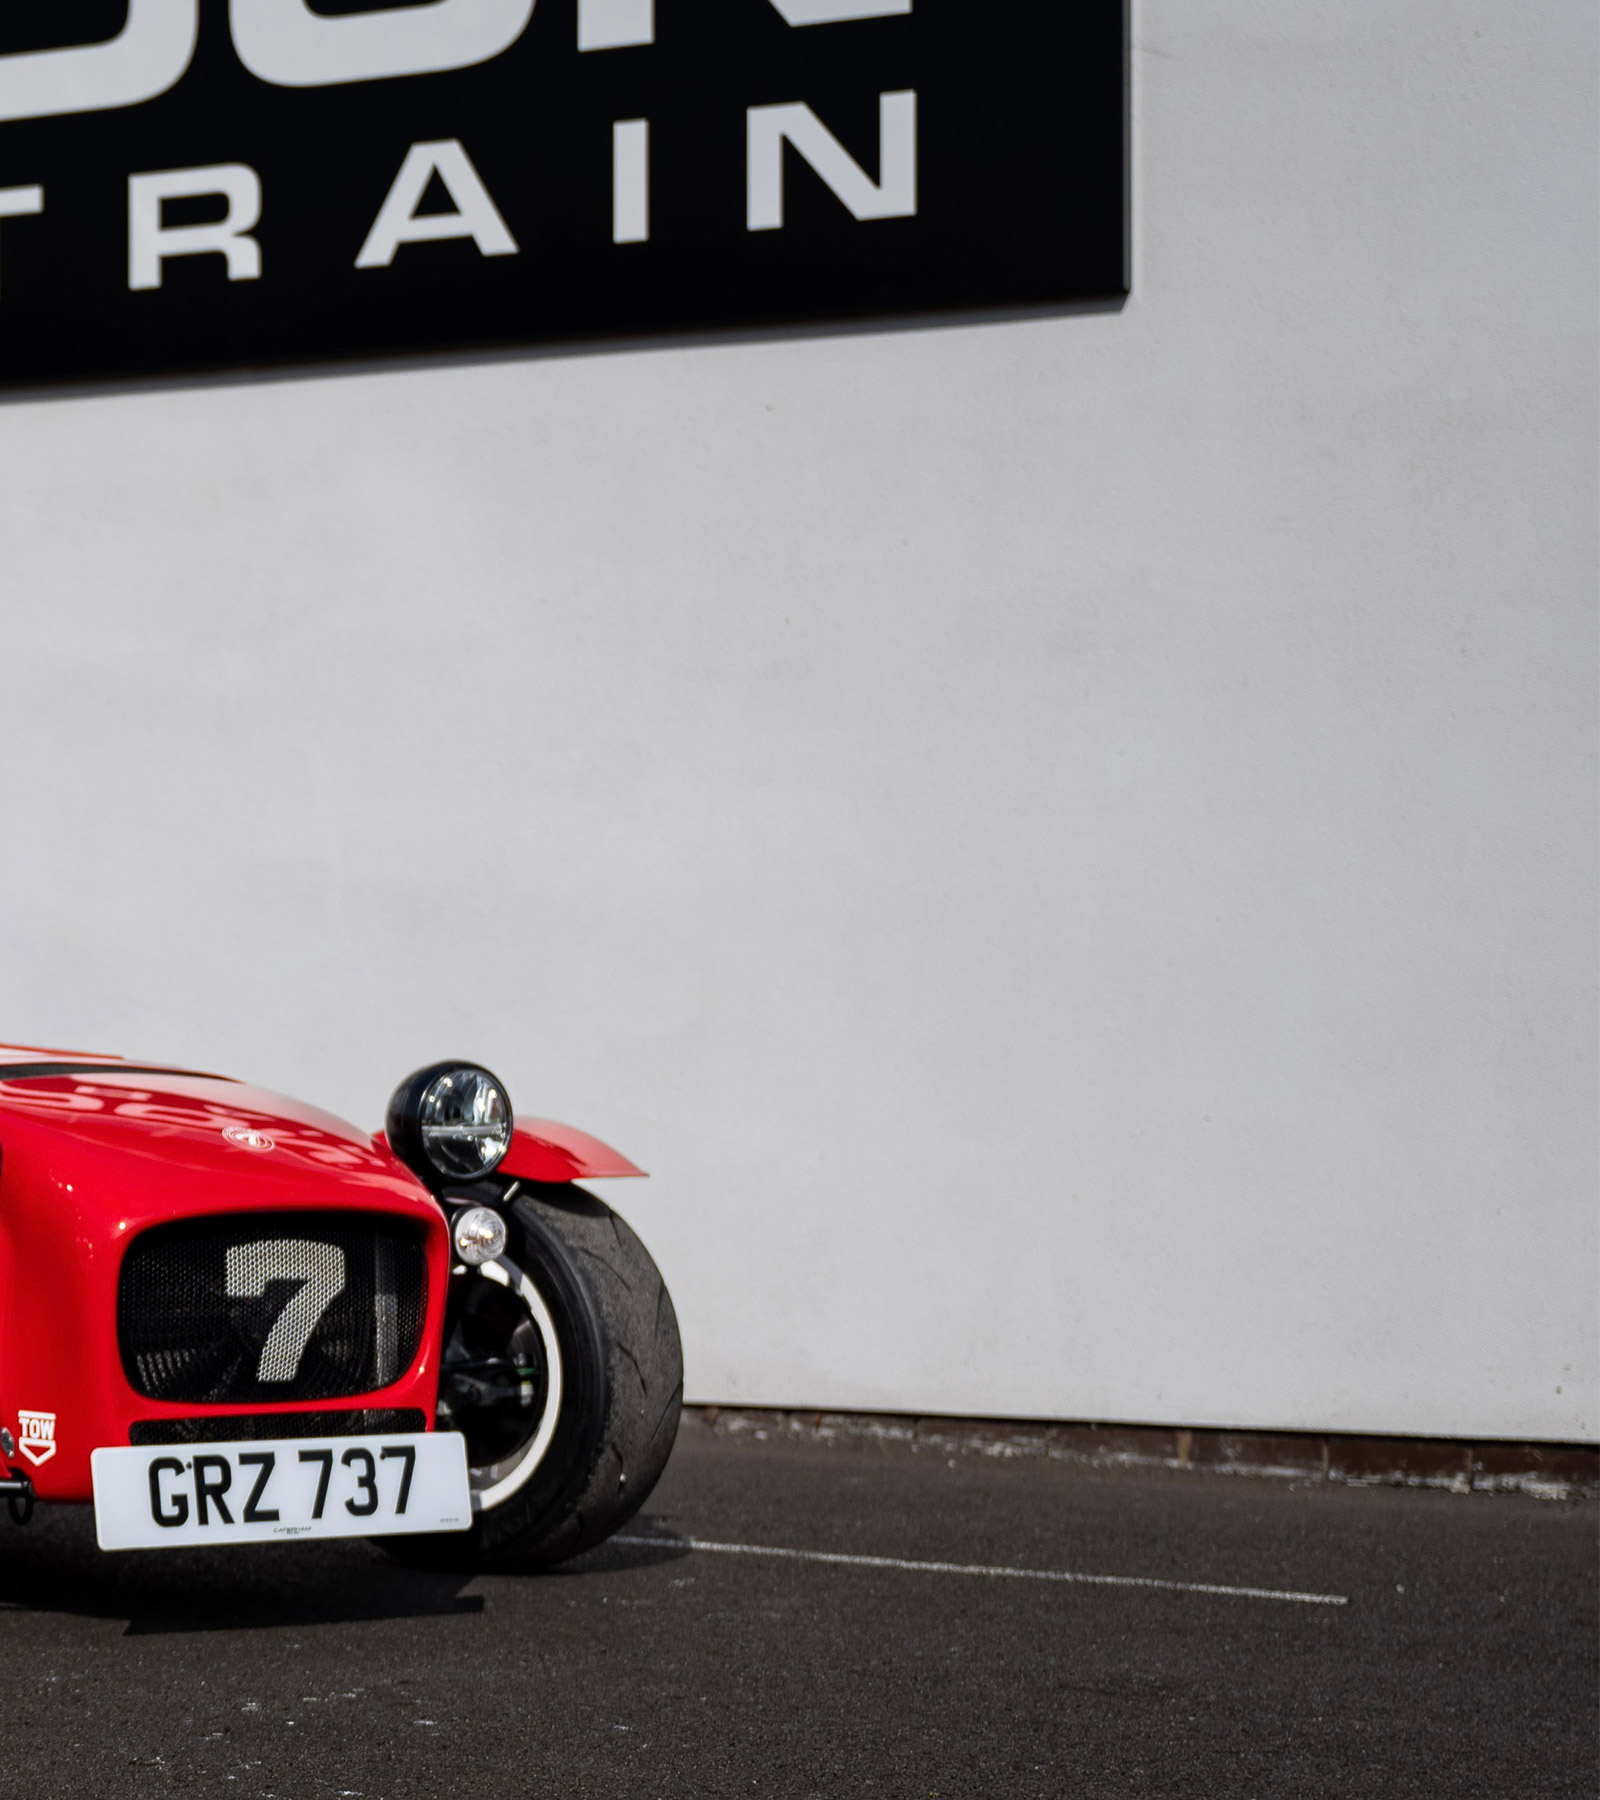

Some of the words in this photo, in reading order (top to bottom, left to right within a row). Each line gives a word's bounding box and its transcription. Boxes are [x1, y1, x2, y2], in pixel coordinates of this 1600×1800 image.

[224, 1239, 346, 1383] 7
[19, 1417, 55, 1440] TOW
[148, 1451, 280, 1528] GRZ
[298, 1445, 416, 1520] 737
